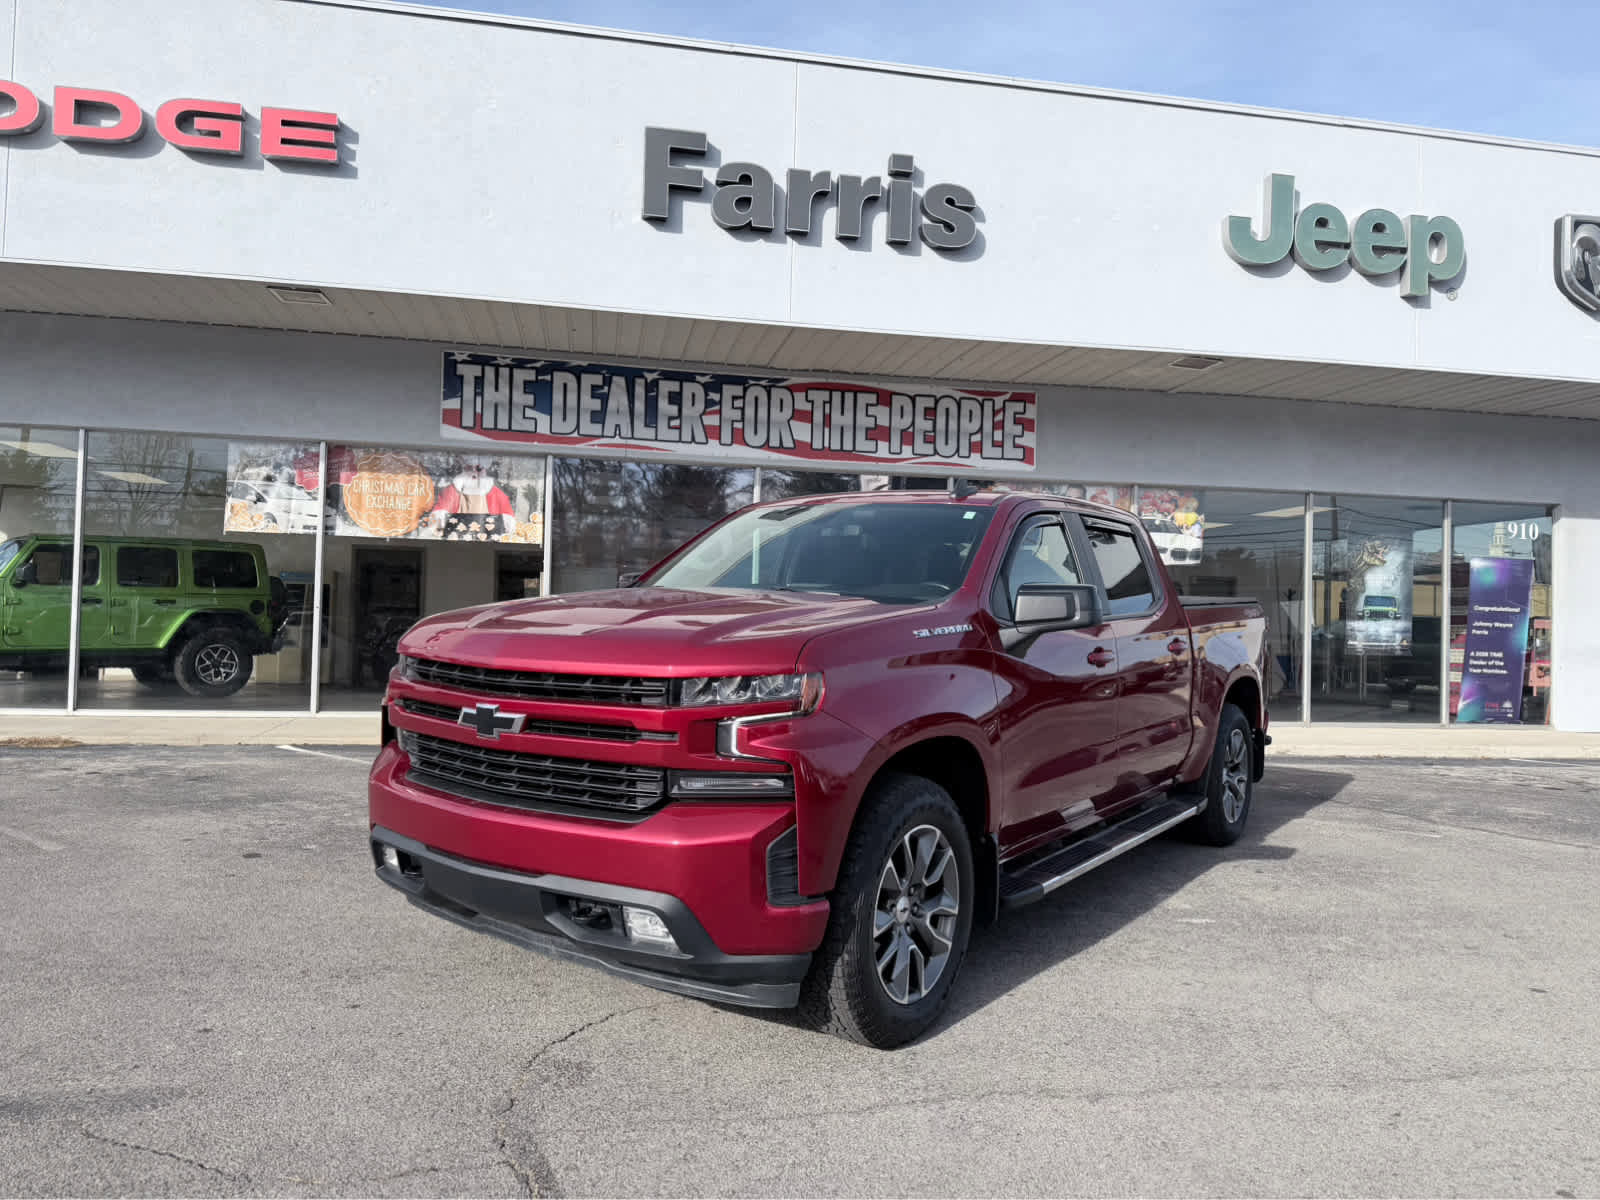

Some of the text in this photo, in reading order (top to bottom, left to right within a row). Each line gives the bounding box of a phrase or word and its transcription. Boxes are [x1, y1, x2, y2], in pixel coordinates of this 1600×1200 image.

[642, 126, 977, 250] Farris
[1222, 172, 1465, 298] Jeep
[456, 364, 1026, 460] THE DEALER FOR THE PEOPLE
[352, 479, 426, 496] CHRISTMAS CAR
[366, 495, 413, 511] EXCHANGE
[1507, 522, 1539, 540] 910
